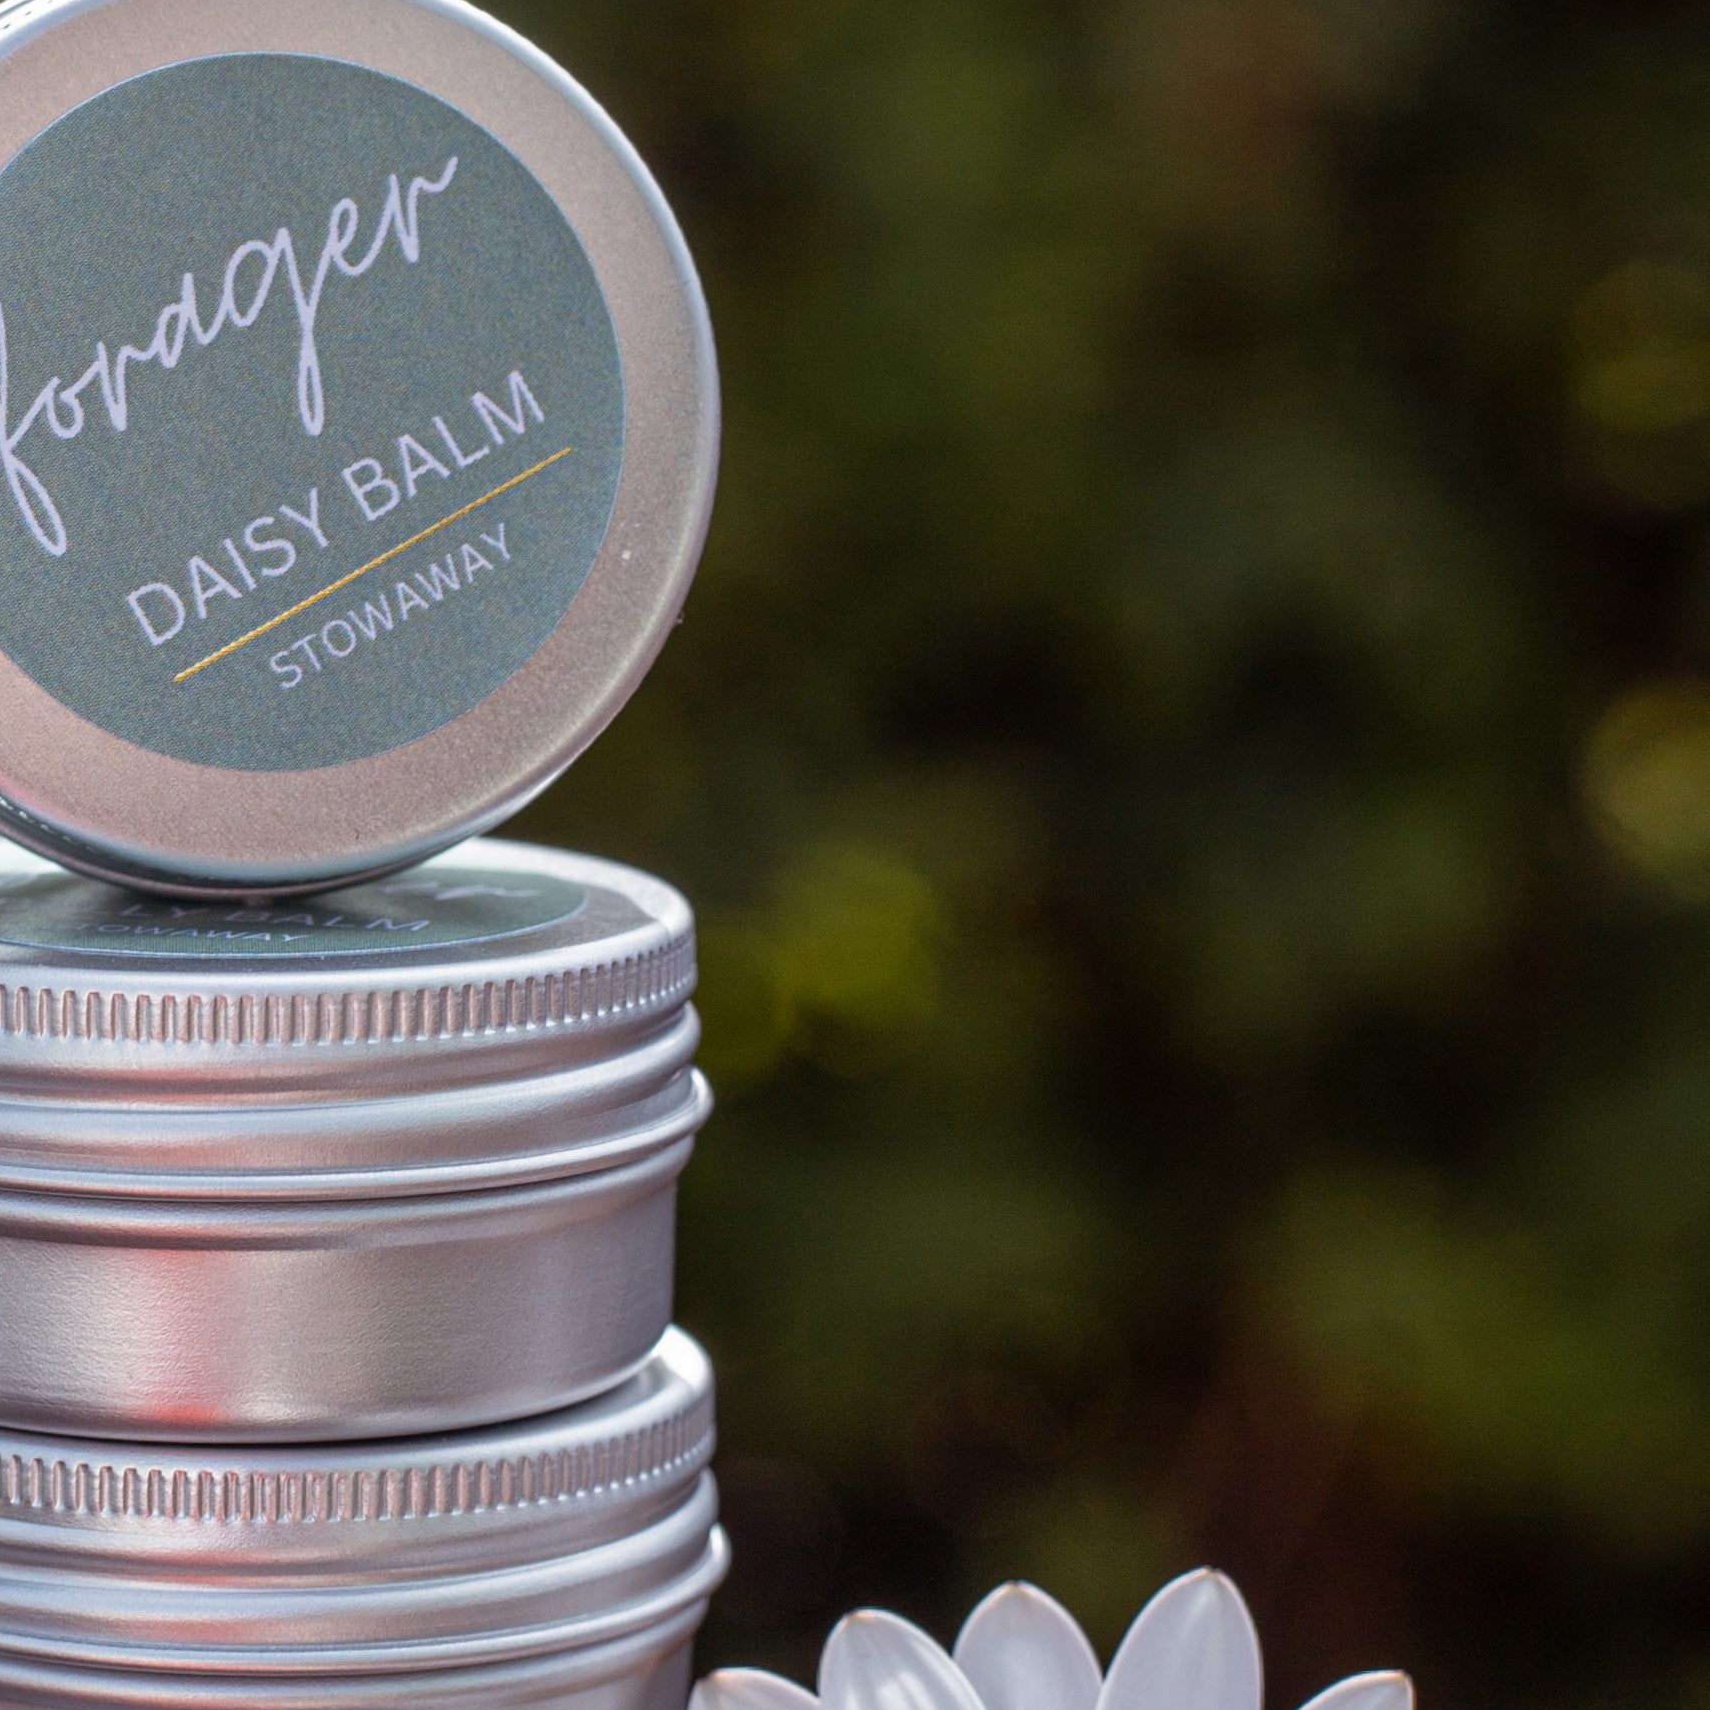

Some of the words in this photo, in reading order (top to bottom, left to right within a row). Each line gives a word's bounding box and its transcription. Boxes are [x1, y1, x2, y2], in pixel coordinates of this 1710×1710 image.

[125, 492, 332, 646] DAISY
[341, 369, 545, 521] BALM
[269, 521, 513, 689] STOWAWAY
[60, 922, 308, 943] TOWAWAY
